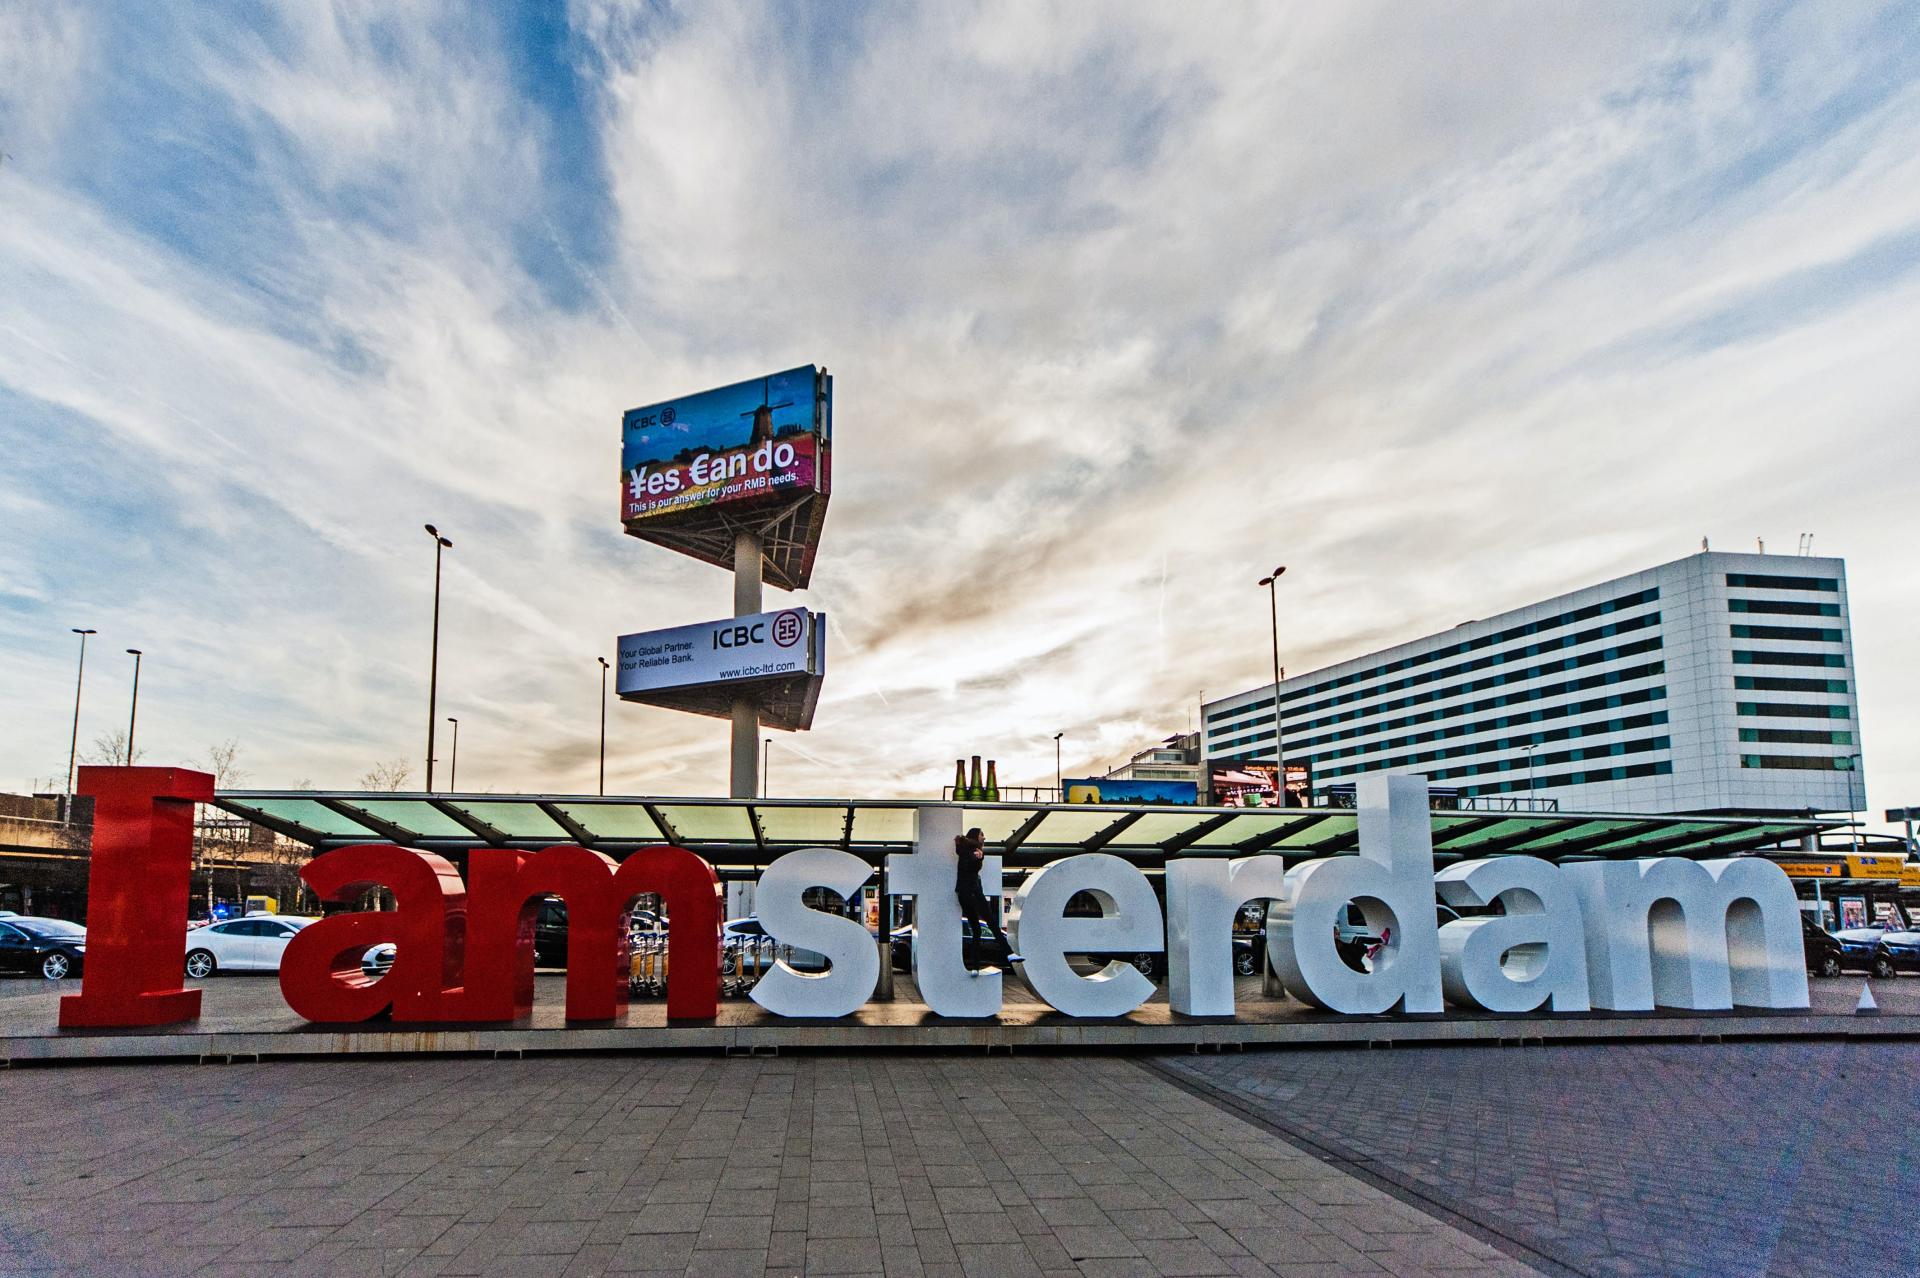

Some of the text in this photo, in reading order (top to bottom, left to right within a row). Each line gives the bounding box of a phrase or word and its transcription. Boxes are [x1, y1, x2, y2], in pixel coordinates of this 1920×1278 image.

[630, 414, 657, 431] ICBC
[753, 440, 799, 472] do.
[629, 472, 799, 513] This is our answer for your RMB needs.
[712, 623, 764, 650] ICBC
[620, 640, 694, 659] Your Global Partner.
[619, 654, 694, 671] Your Reliable Bank.
[719, 661, 795, 679] www.icbc-ltd.com
[59, 765, 216, 1028] I
